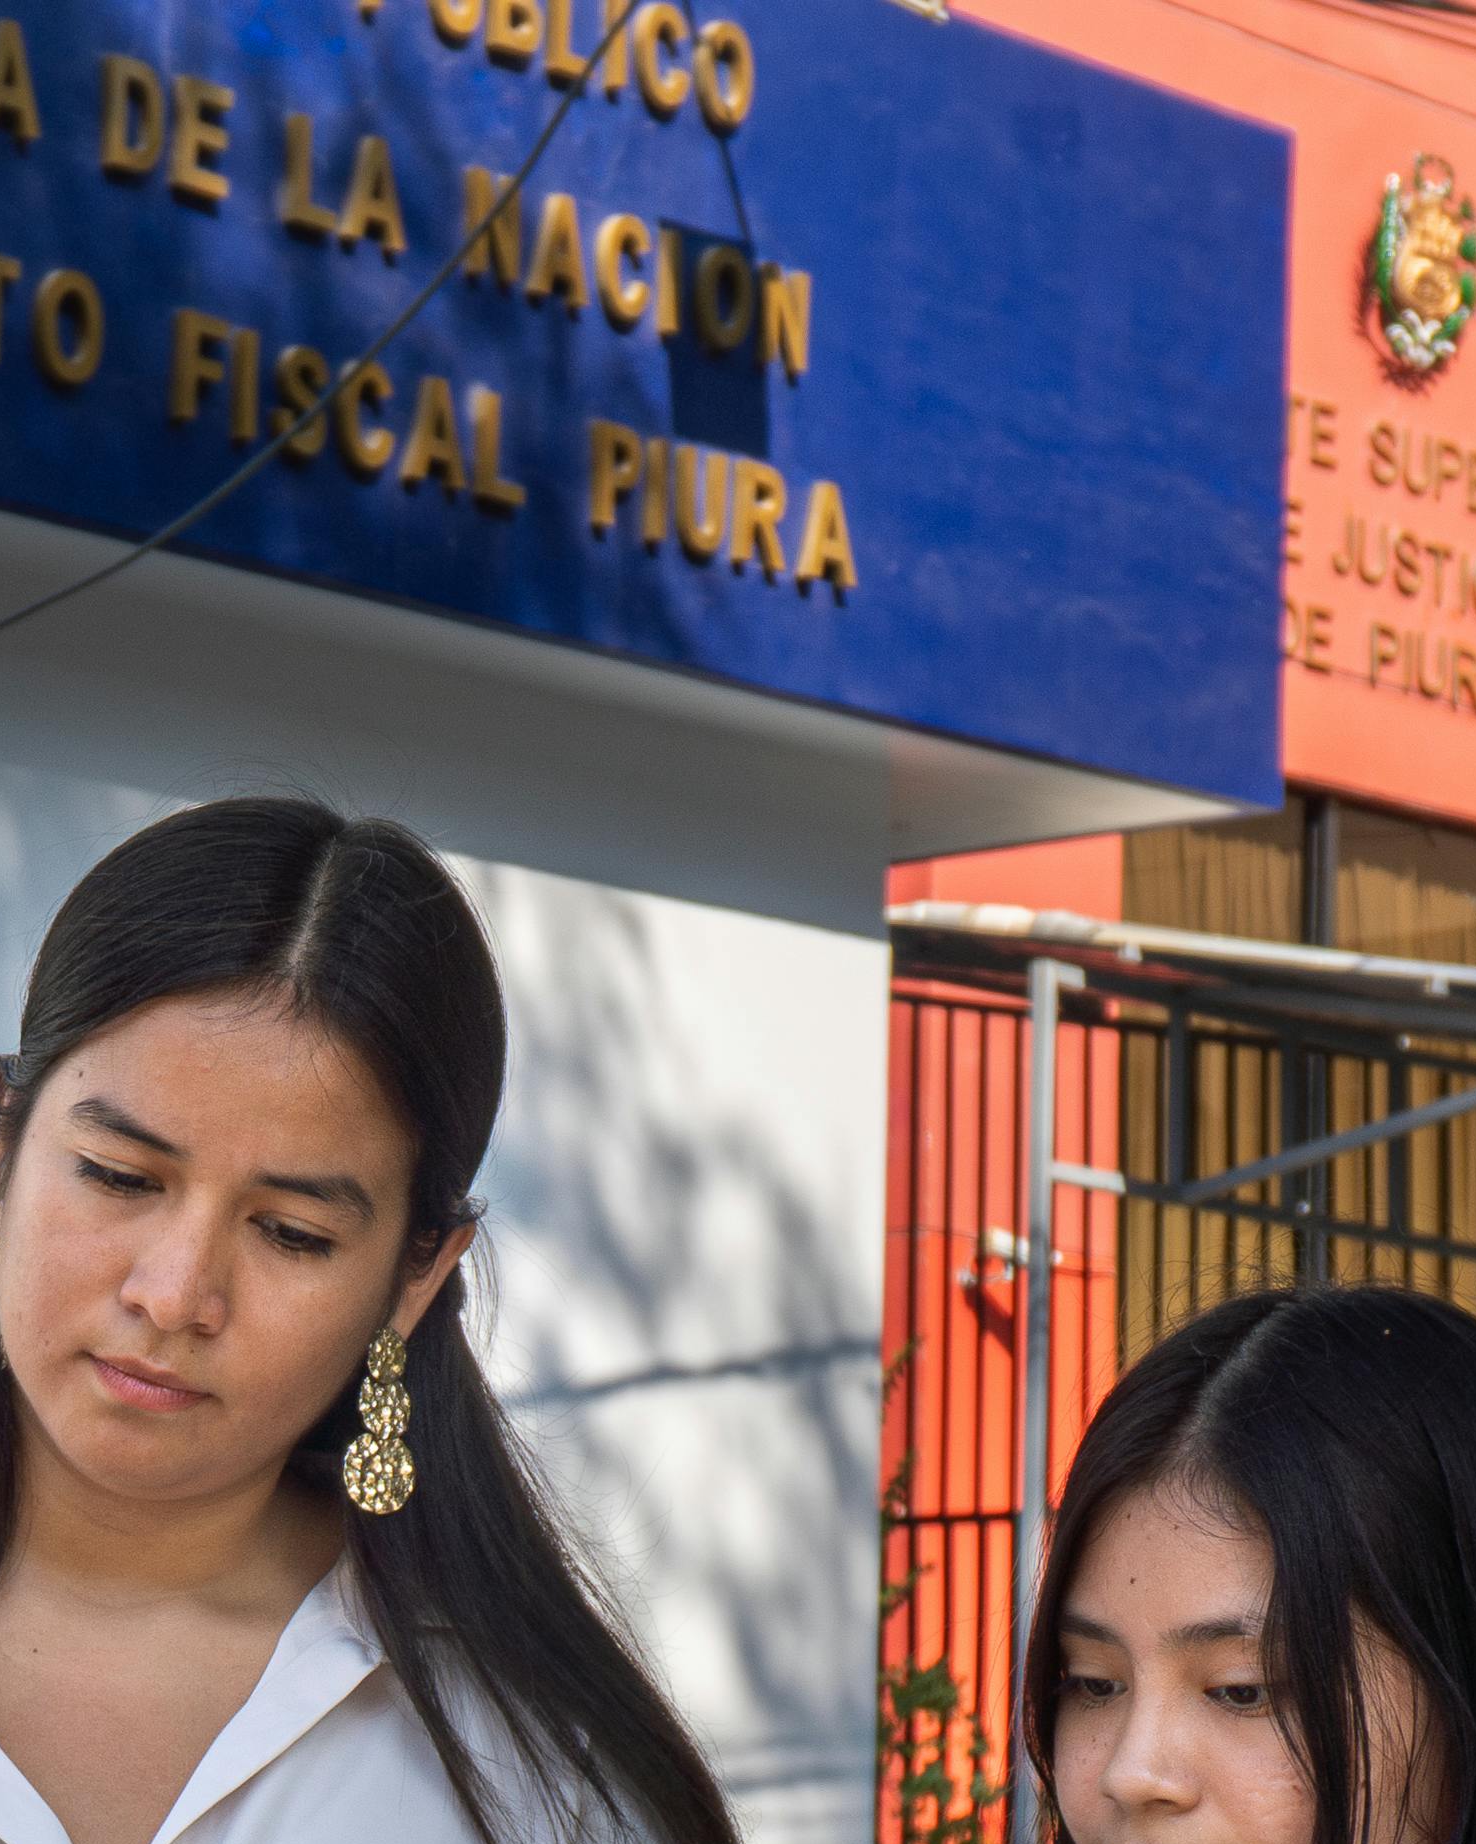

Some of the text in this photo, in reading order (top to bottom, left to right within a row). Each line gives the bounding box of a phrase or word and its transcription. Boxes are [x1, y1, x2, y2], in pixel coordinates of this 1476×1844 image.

[359, 0, 754, 130] BLICO
[99, 53, 236, 201] DE
[280, 113, 407, 256] LA
[463, 166, 811, 376] NACION
[168, 308, 526, 506] FISCAL
[589, 417, 857, 590] PIURA
